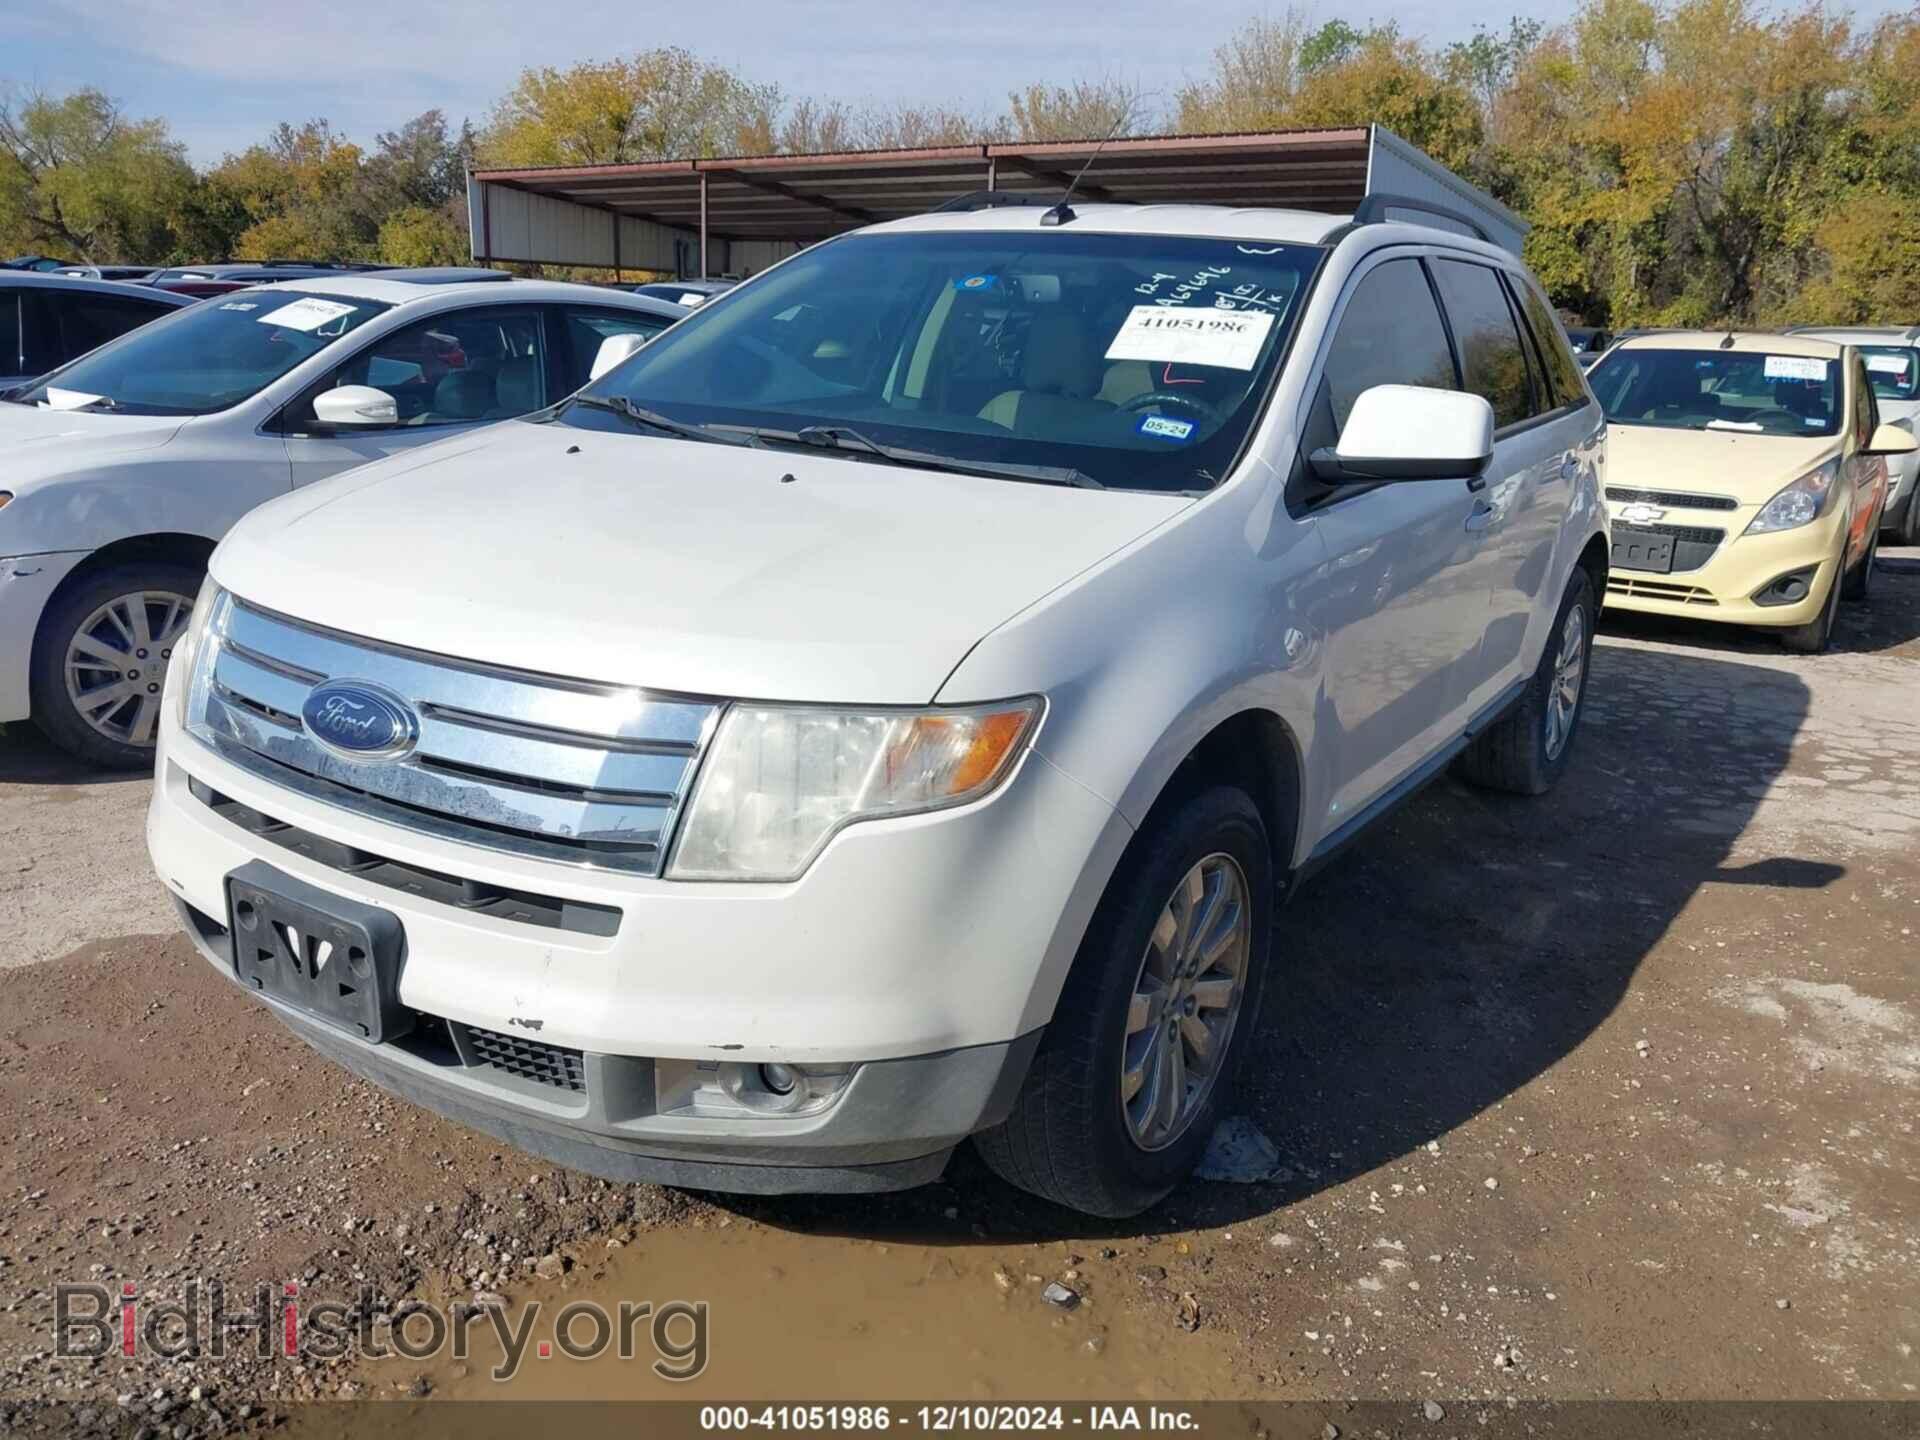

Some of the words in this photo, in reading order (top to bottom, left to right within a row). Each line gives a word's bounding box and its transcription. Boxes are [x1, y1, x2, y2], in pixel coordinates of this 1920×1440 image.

[1138, 317, 1249, 333] 41051986
[1145, 420, 1188, 435] 05-24
[317, 696, 377, 736] Ford
